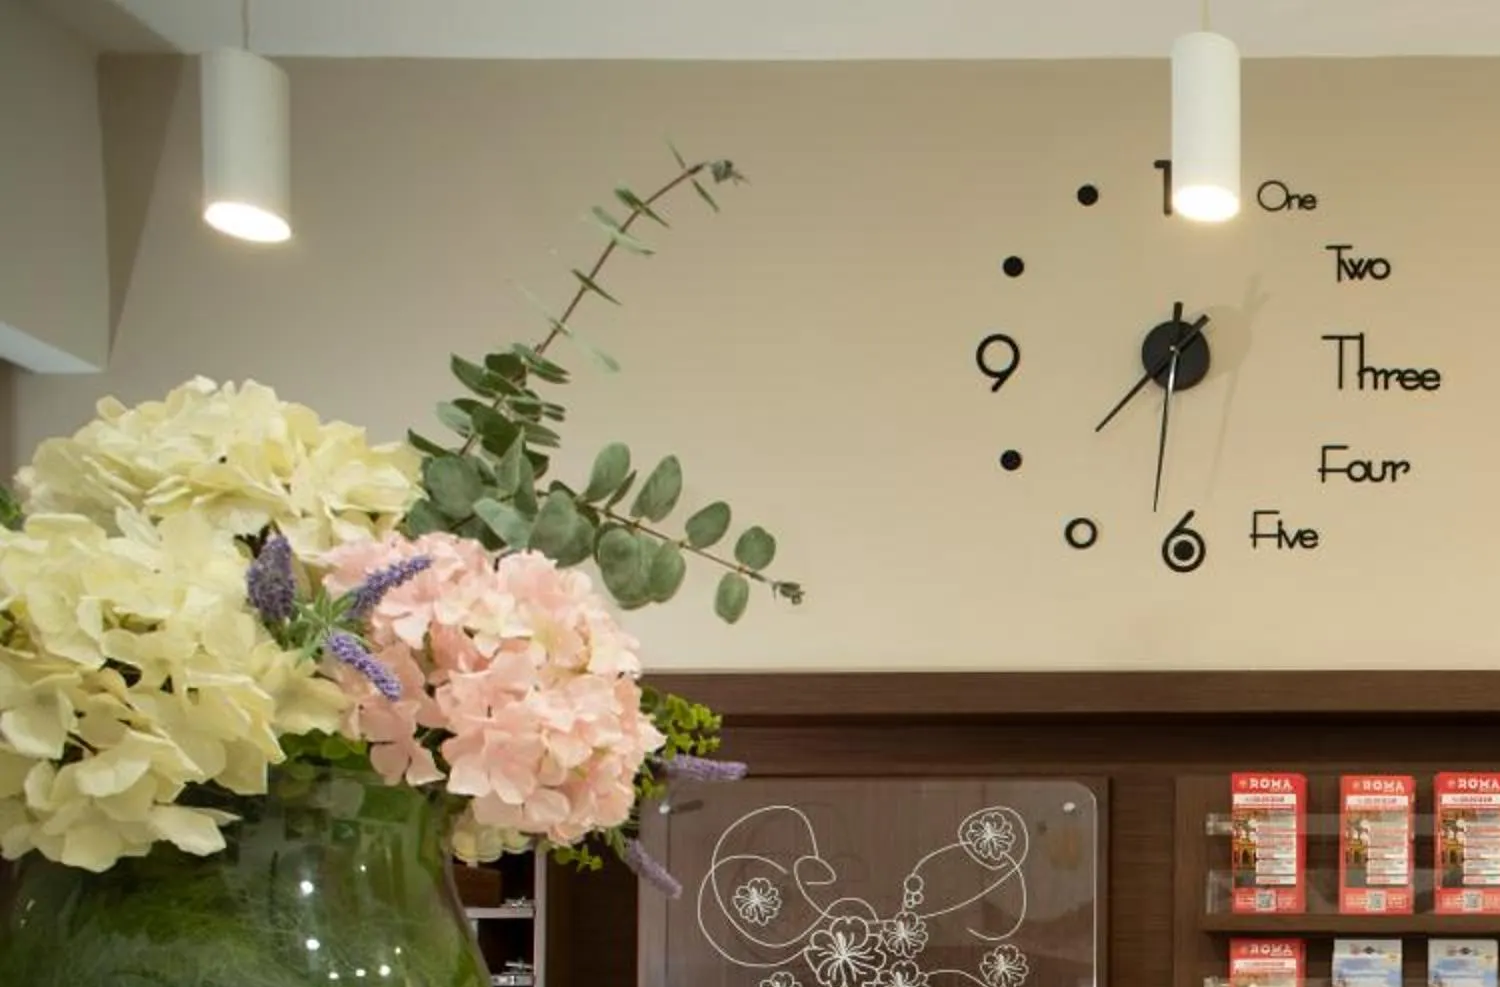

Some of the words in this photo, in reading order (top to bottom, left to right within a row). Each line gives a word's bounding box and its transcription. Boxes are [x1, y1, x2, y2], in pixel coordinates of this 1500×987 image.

[1257, 180, 1317, 210] One
[1326, 245, 1391, 281] Two
[976, 334, 1020, 392] 9
[1322, 333, 1441, 390] Three
[1318, 445, 1410, 482] Four
[1162, 510, 1206, 572] 6
[1250, 510, 1319, 549] Five
[1249, 778, 1293, 790] ROMA
[1361, 780, 1405, 792] ROMA
[1457, 778, 1500, 790] ROMA
[1250, 945, 1293, 956] ROMA
